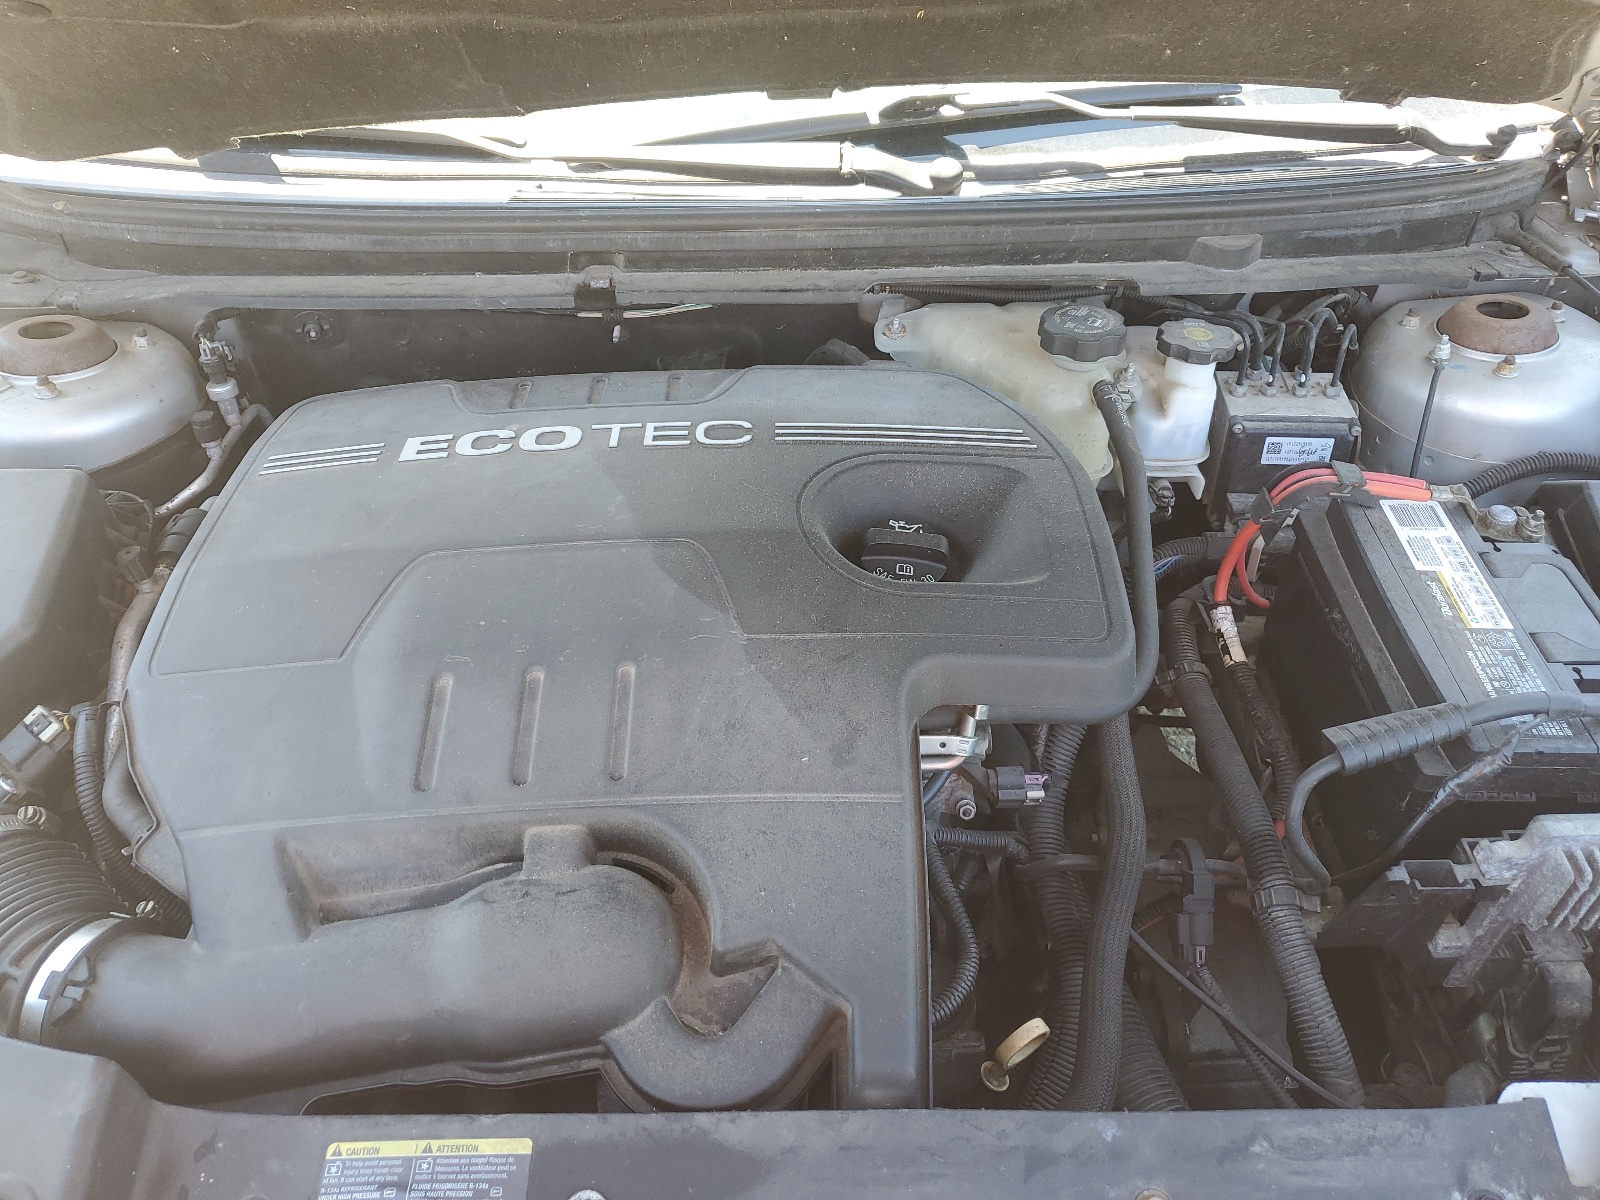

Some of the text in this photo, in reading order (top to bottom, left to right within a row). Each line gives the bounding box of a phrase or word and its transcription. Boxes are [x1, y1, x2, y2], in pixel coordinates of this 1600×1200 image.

[398, 420, 753, 462] ECOTEC
[1425, 580, 1454, 616] Duralast
[346, 1146, 380, 1156] CAUTION
[436, 1144, 479, 1153] ATTENTION
